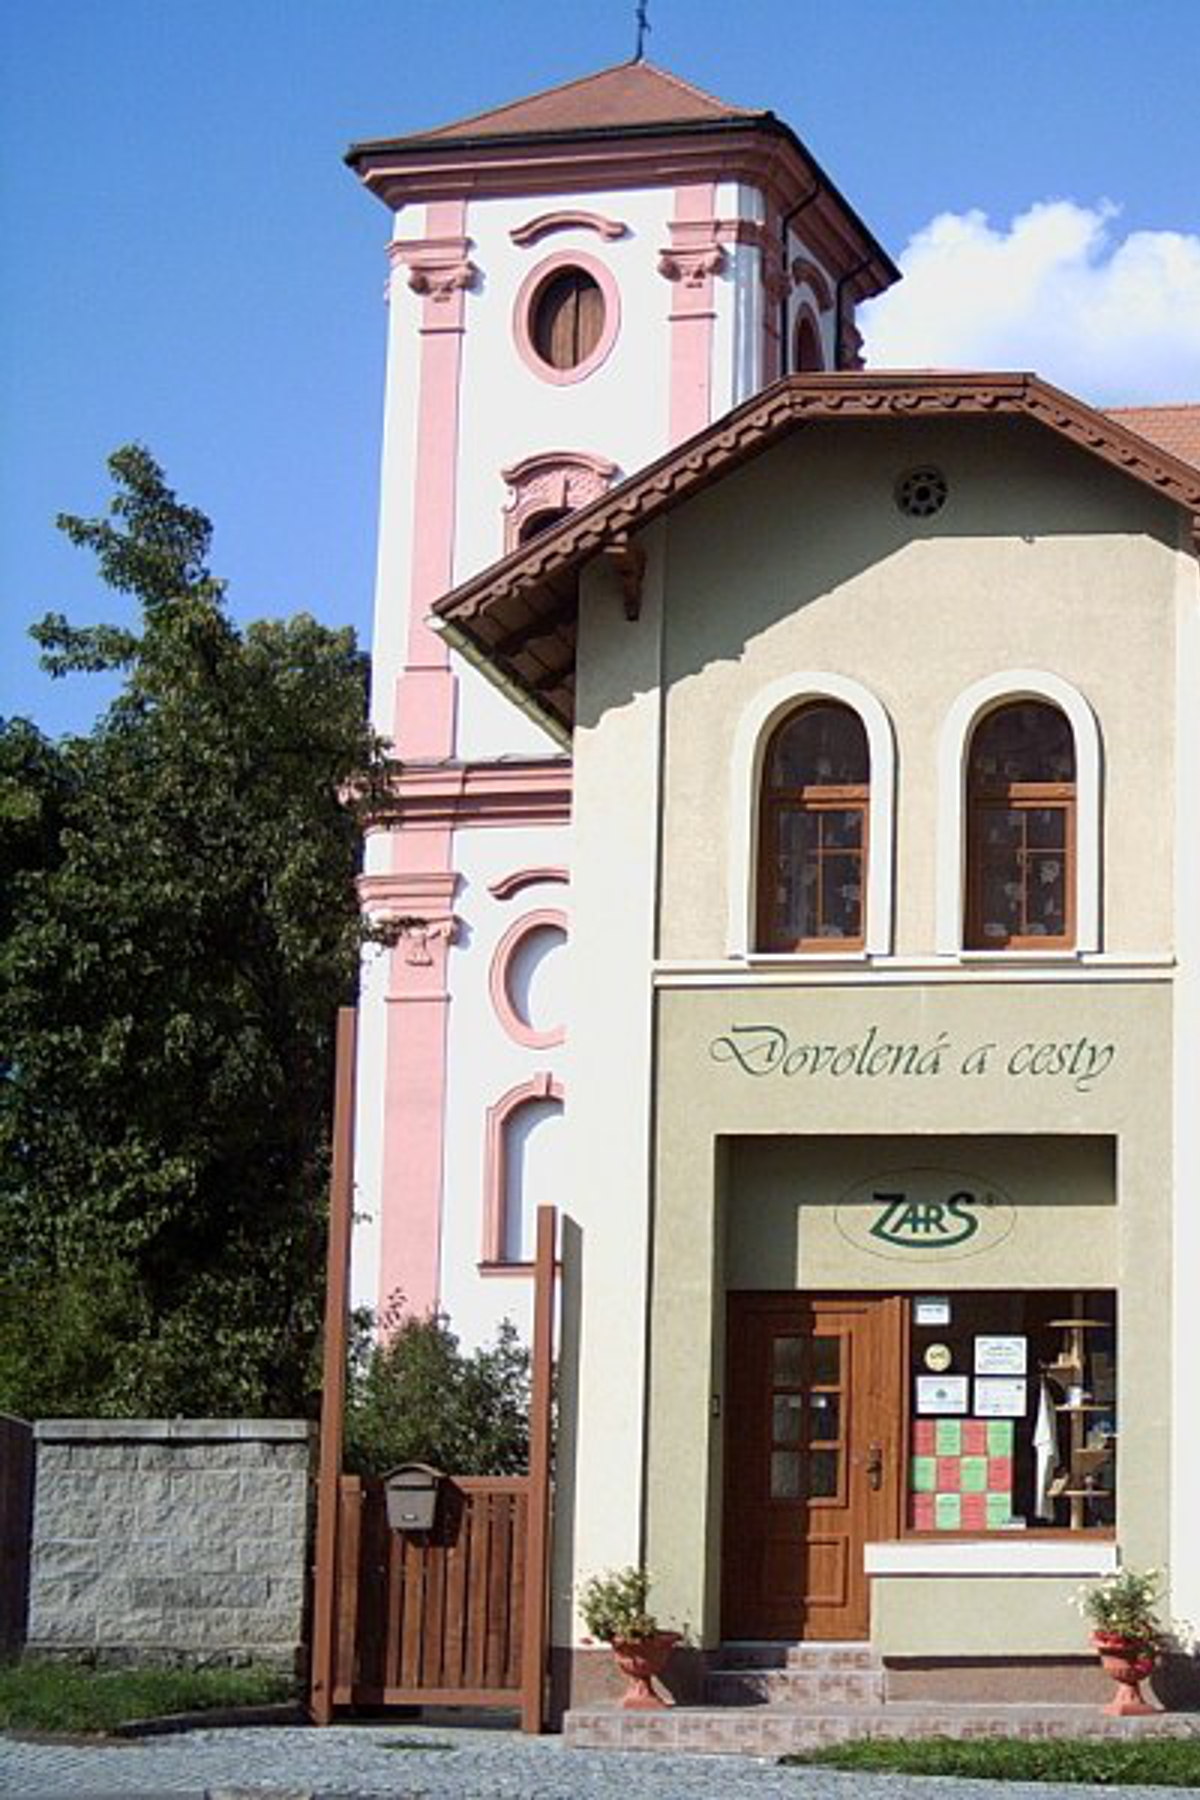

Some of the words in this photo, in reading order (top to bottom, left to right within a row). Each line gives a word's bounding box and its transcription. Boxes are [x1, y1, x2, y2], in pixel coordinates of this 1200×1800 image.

[710, 1026, 950, 1076] Dovolená
[961, 1043, 995, 1075] a
[1007, 1037, 1115, 1092] cesty
